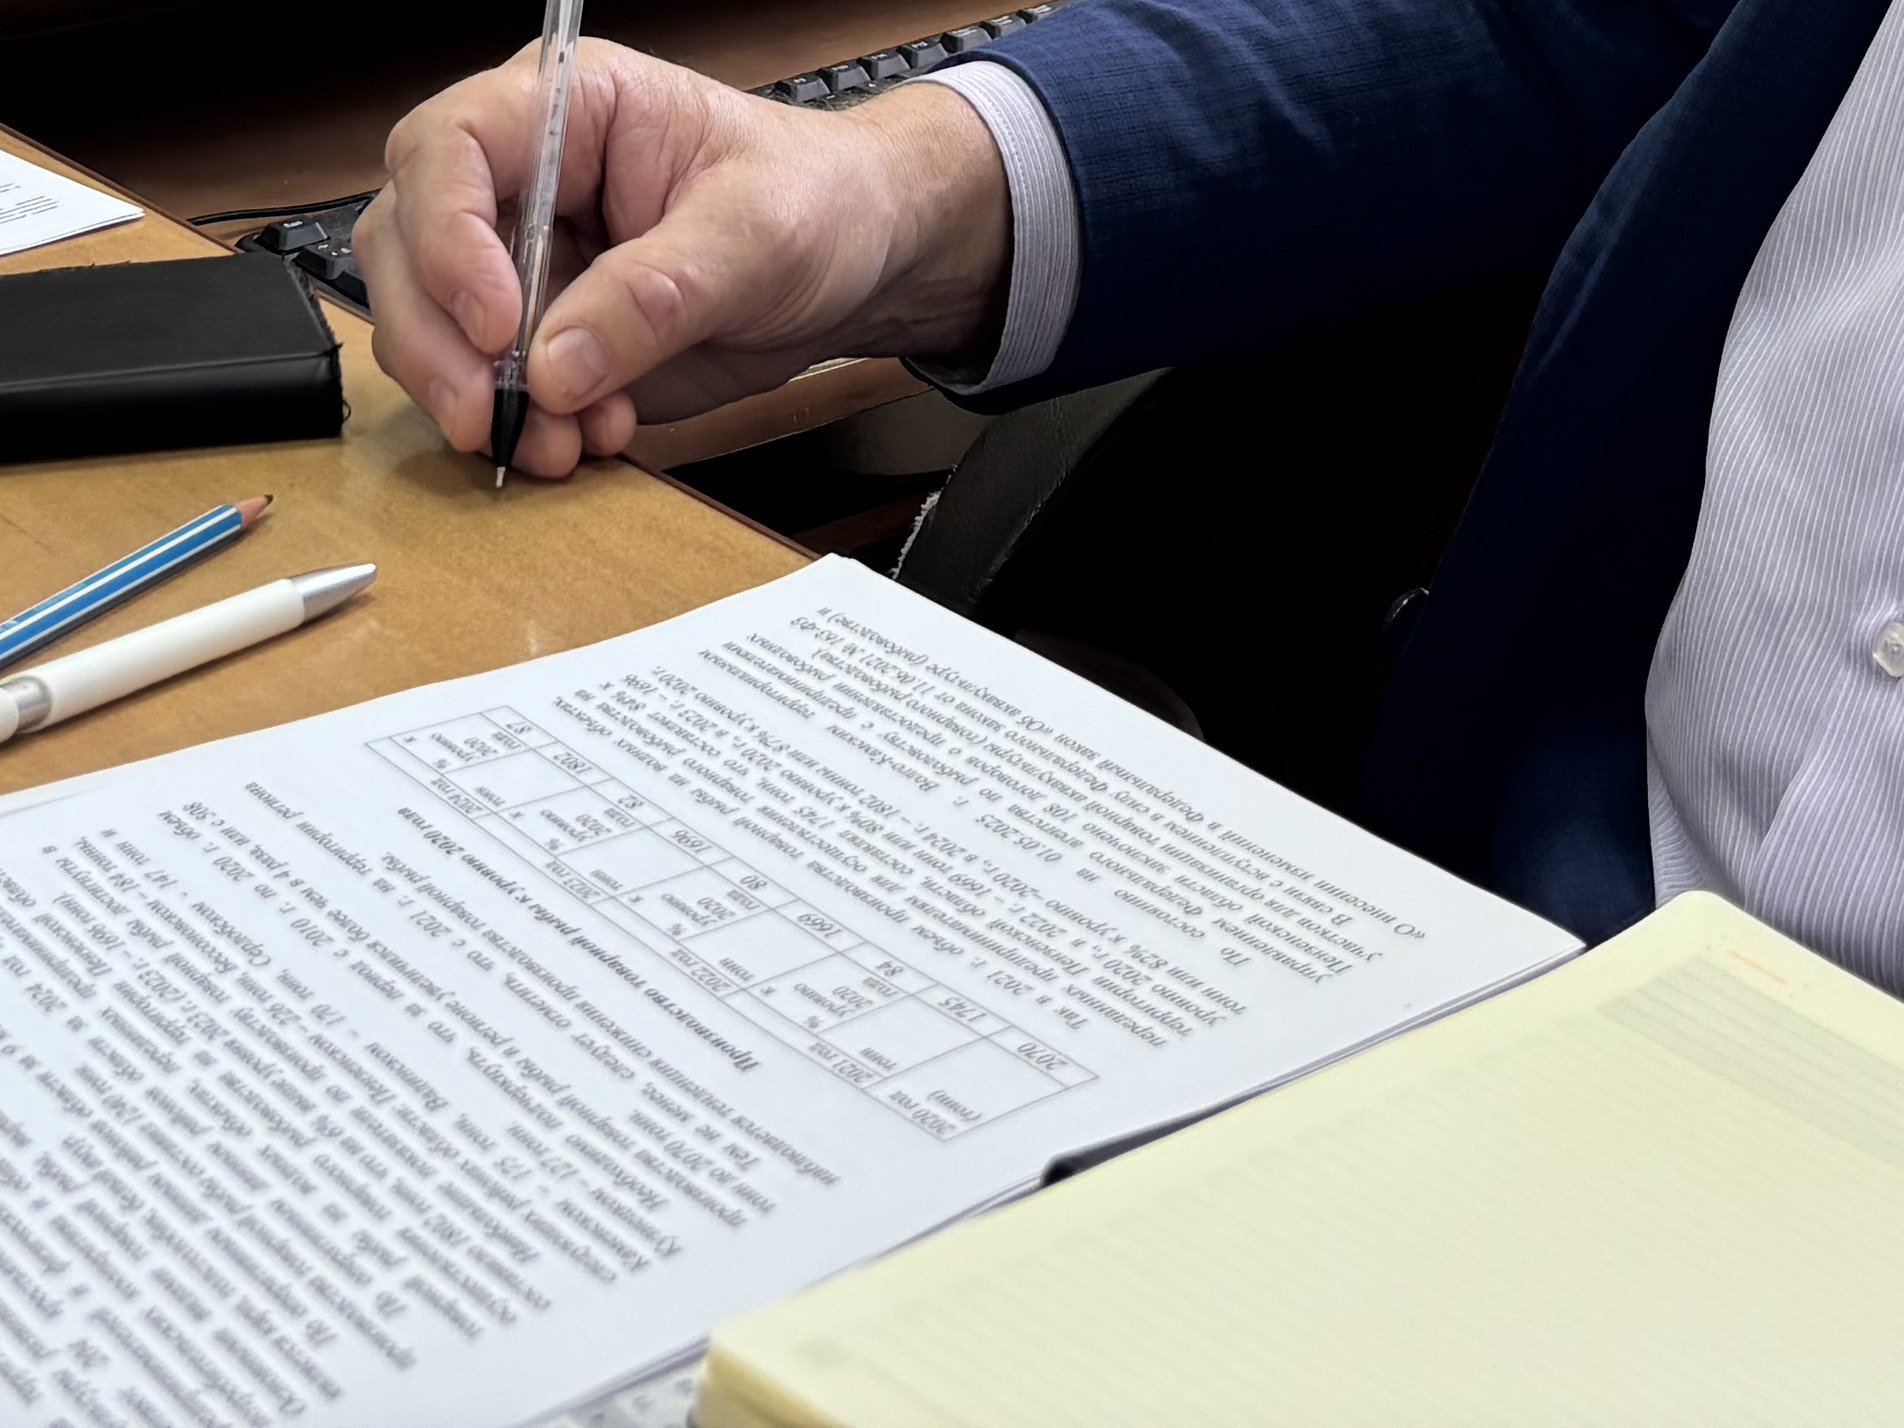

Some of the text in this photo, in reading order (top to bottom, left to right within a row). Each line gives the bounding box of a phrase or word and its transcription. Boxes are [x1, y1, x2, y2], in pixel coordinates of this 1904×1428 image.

[421, 827, 466, 856] 2020
[505, 719, 1070, 1072] 2070 1745 84 1669 80 1696 82 1802 87
